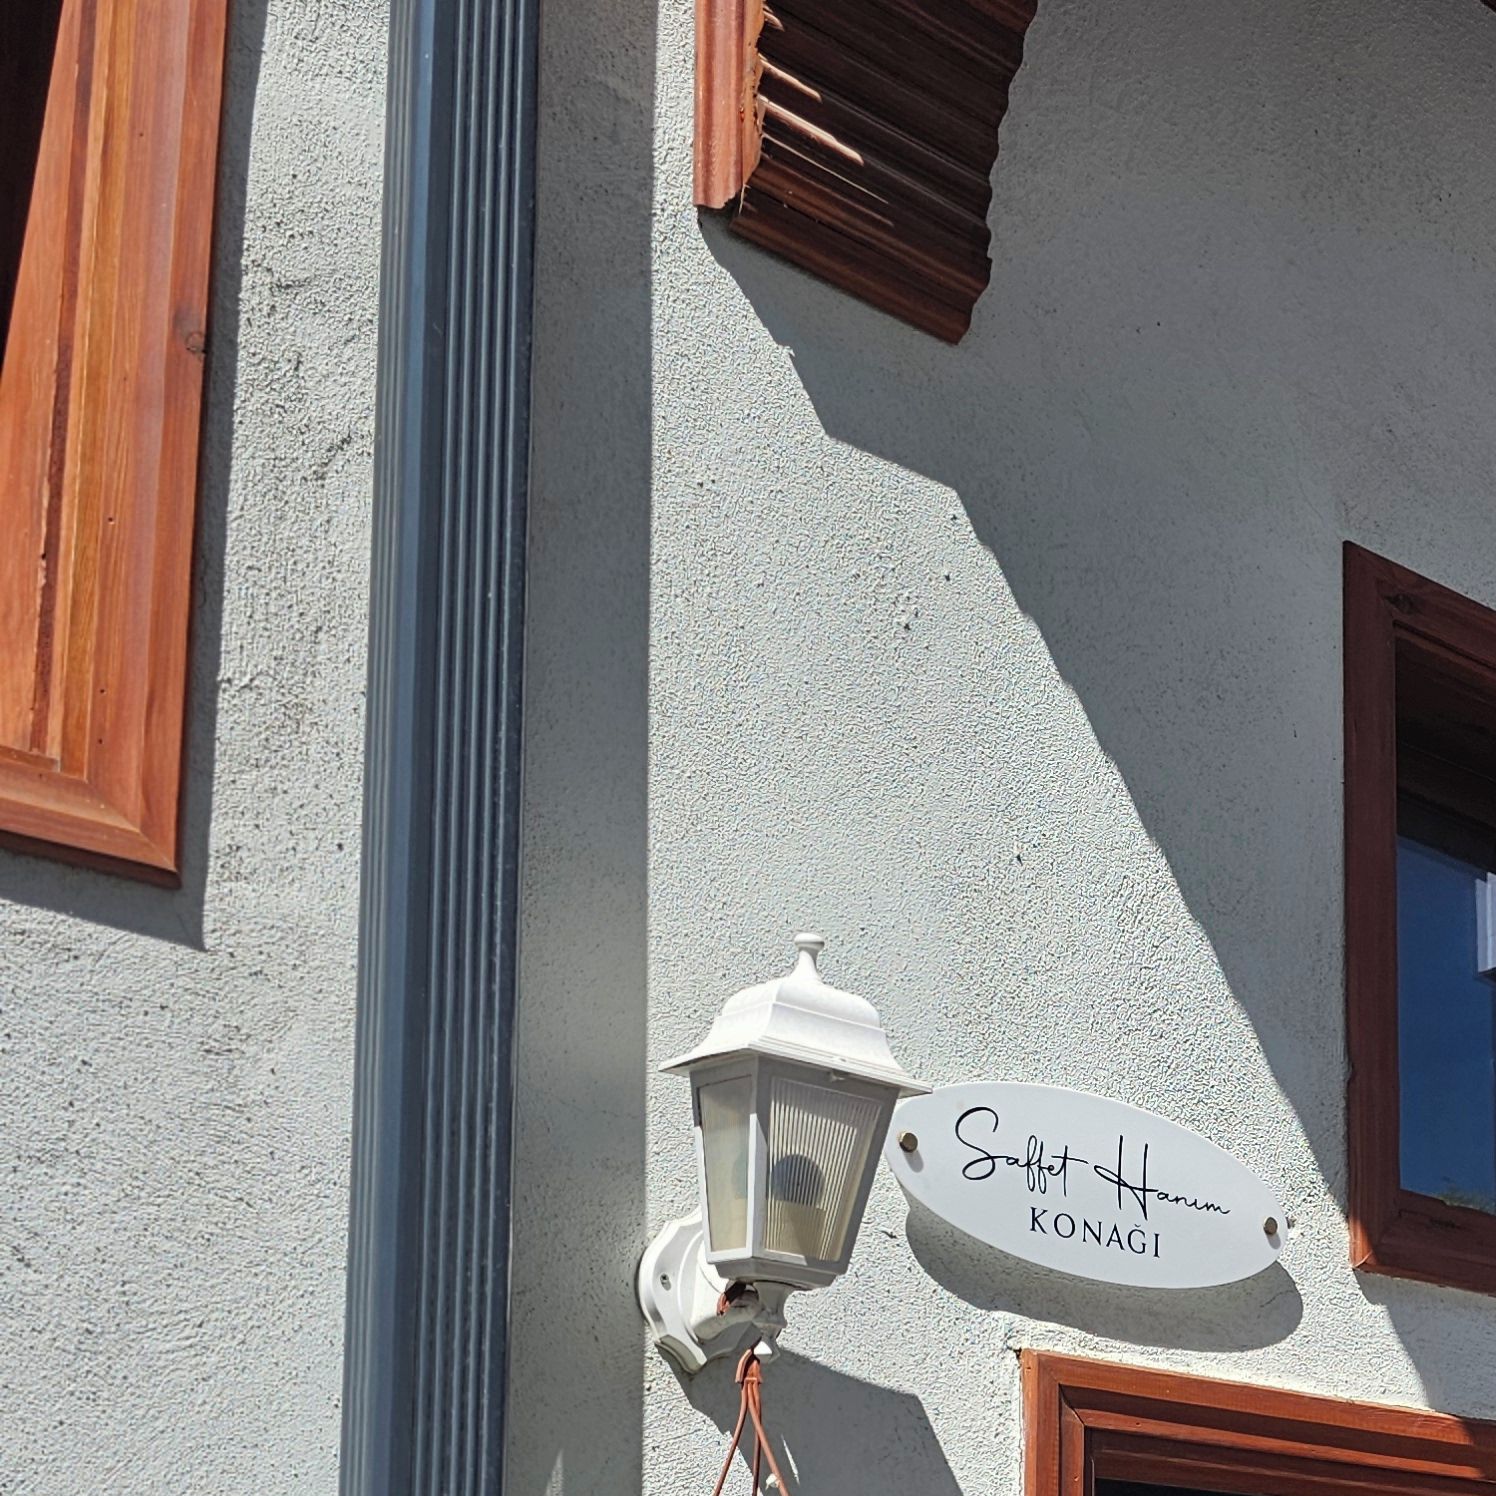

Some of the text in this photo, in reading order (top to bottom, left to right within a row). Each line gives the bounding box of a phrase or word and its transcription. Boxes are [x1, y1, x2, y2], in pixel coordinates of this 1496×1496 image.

[954, 1105, 1231, 1221] Saffet Hanım
[1028, 1205, 1161, 1259] KONAĞI
